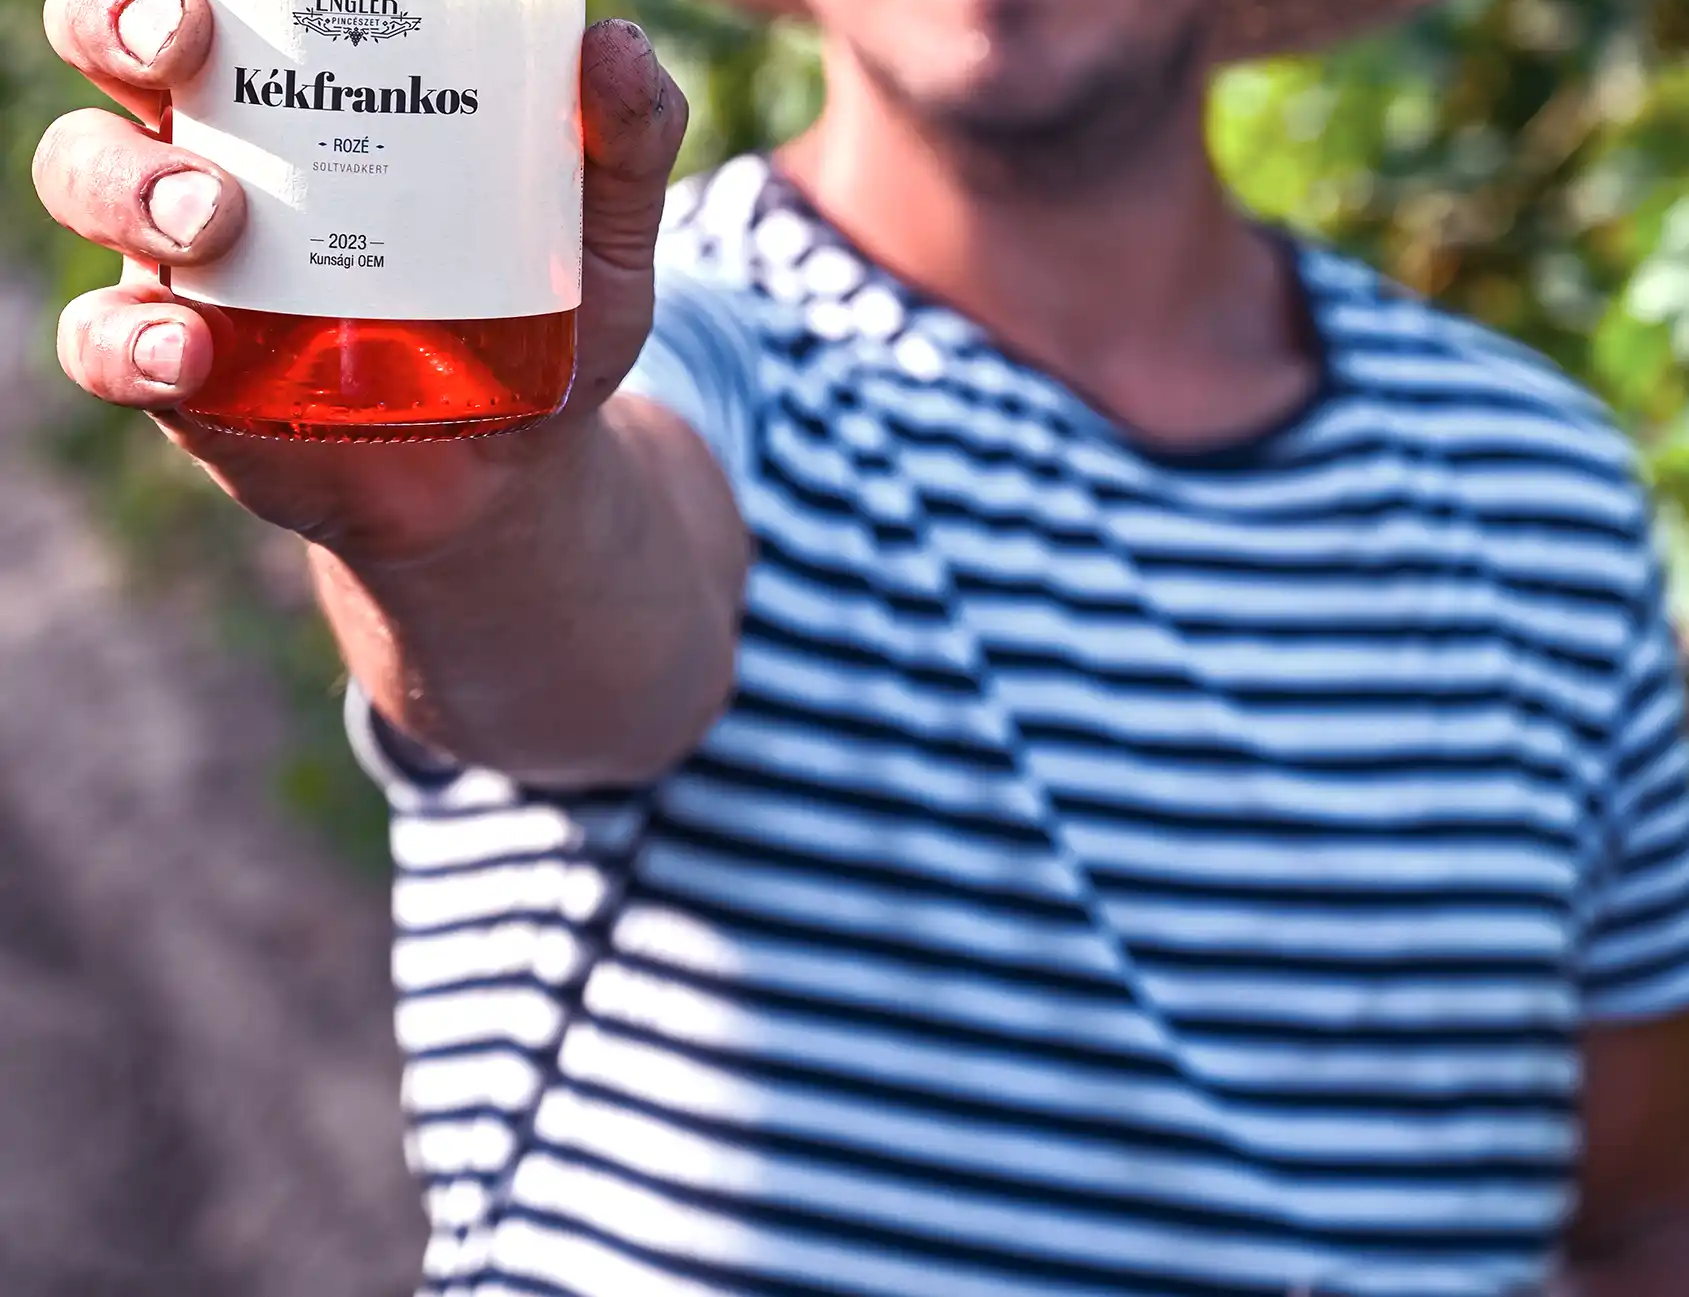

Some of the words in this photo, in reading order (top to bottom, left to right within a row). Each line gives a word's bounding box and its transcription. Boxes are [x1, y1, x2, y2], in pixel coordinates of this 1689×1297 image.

[331, 16, 380, 27] PINCÉSZET
[233, 66, 479, 115] Kékfrankos
[333, 136, 370, 154] ROZÉ
[312, 161, 389, 174] SOLTVADKERT
[309, 252, 354, 269] Kunsági
[357, 254, 385, 268] OEM
